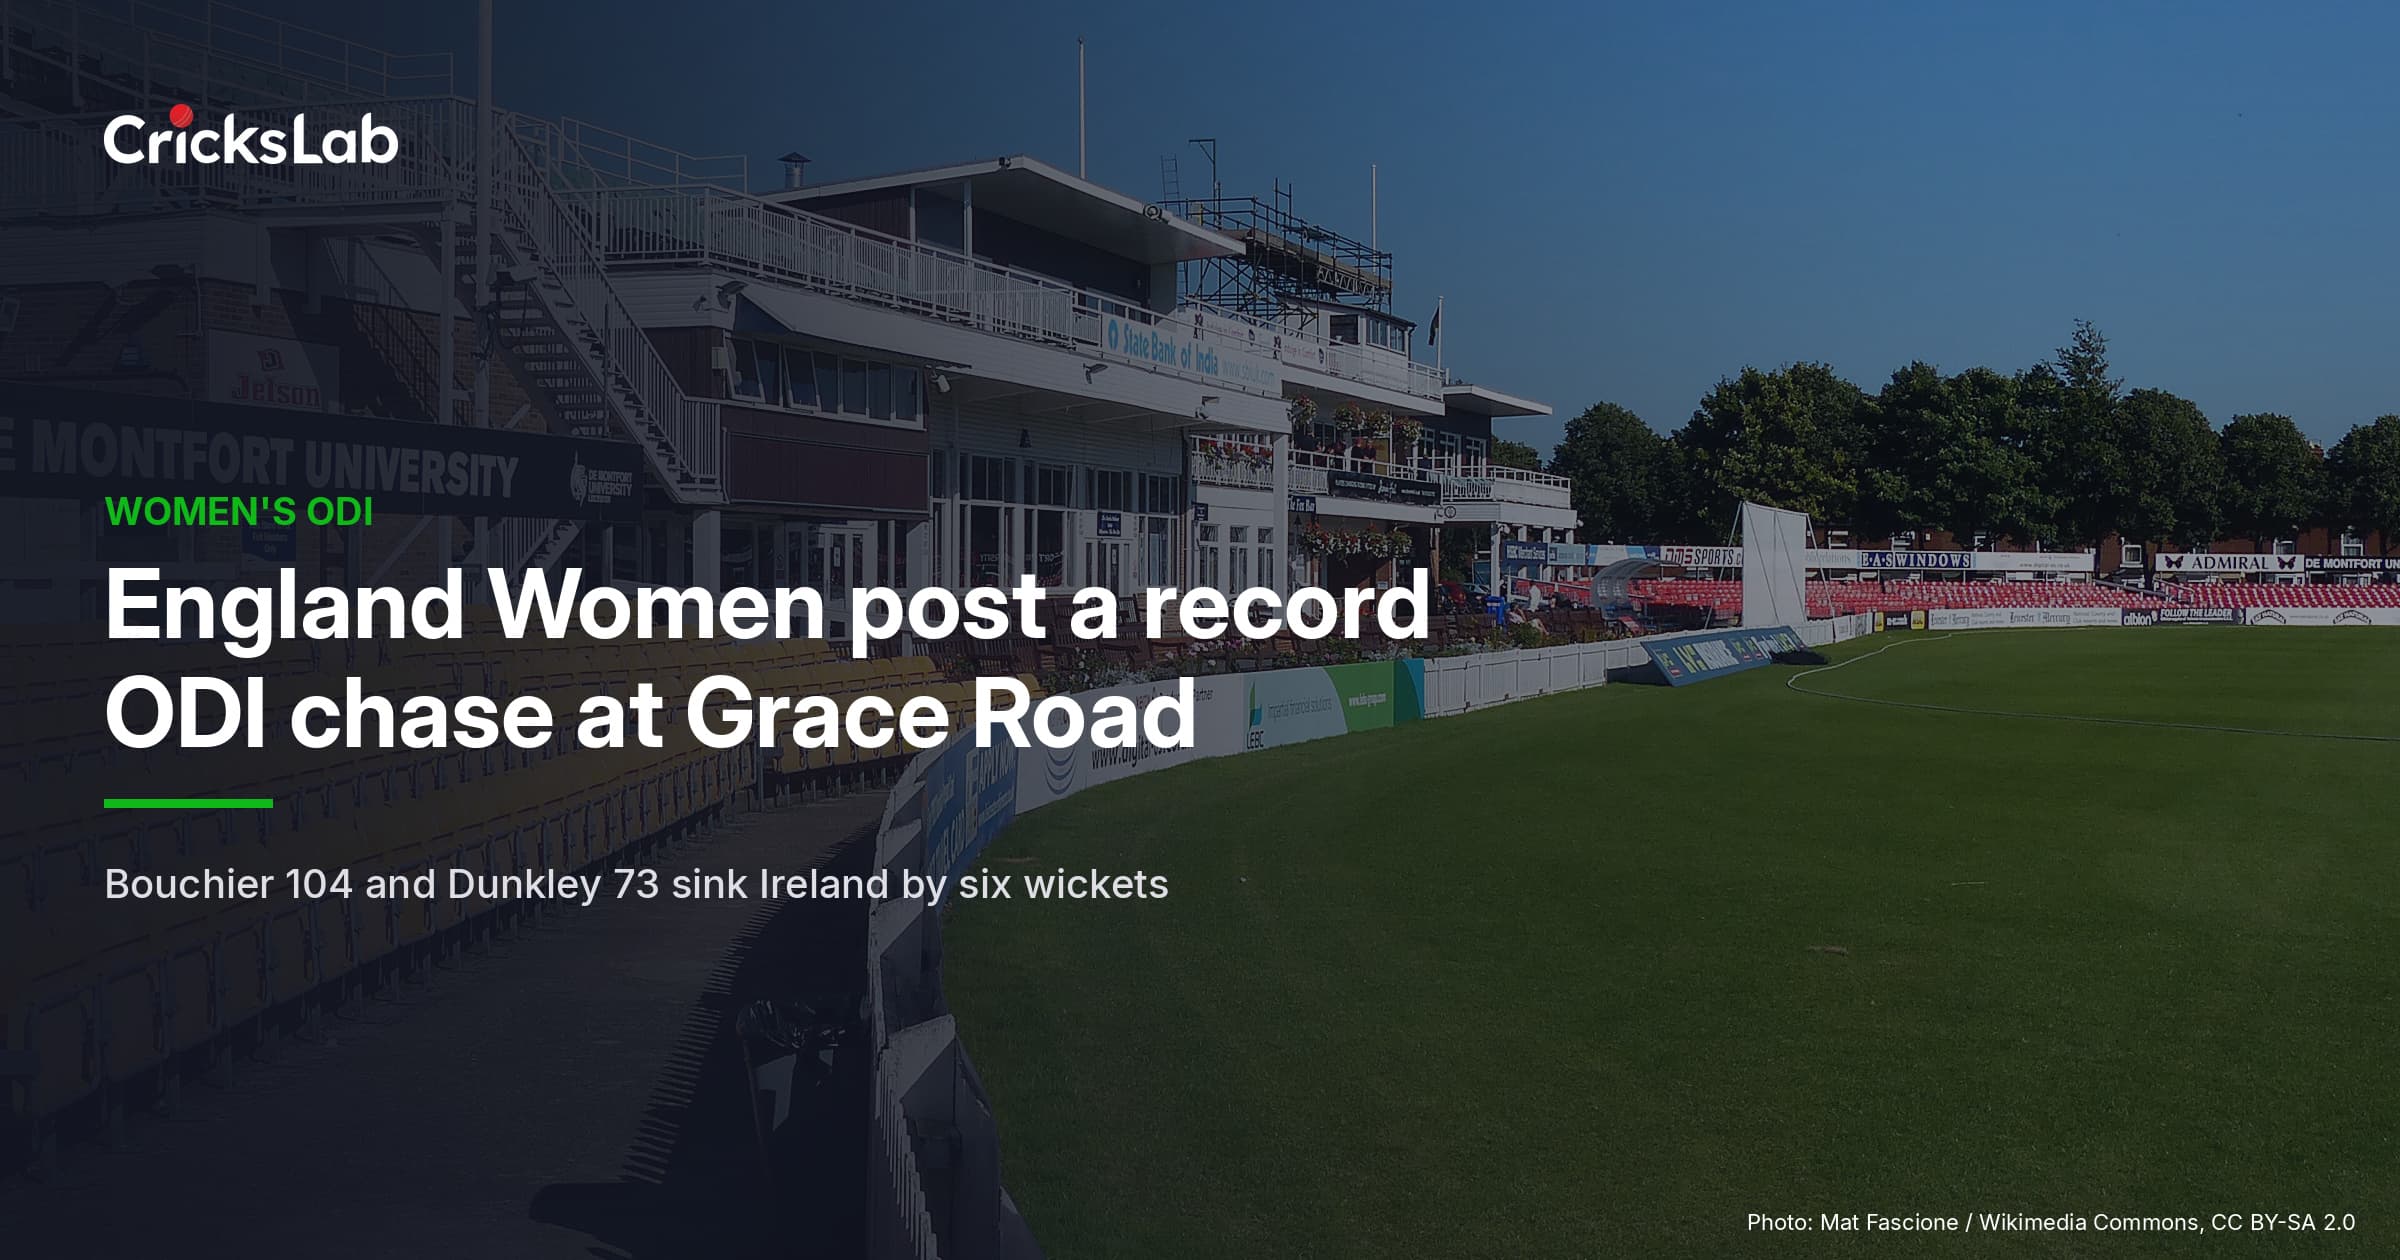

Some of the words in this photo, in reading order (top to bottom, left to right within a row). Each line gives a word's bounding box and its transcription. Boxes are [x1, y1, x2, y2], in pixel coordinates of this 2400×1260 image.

[1124, 322, 1149, 359] State
[1152, 331, 1176, 366] Bank
[1181, 342, 1191, 369] of
[1196, 343, 1218, 376] India
[33, 418, 294, 486] MONTFORT
[305, 439, 520, 499] UNIVERSITY
[1895, 553, 1970, 568] WINDOWS
[2191, 556, 2269, 569] ADMIRAL
[2305, 558, 2321, 569] DE
[2323, 558, 2383, 569] MONTFORT
[2124, 612, 2152, 626] albion
[2160, 608, 2189, 617] FOLLOW
[2190, 608, 2203, 617] THE
[2204, 608, 2233, 617] LEADER
[1247, 730, 1264, 750] LEBC
